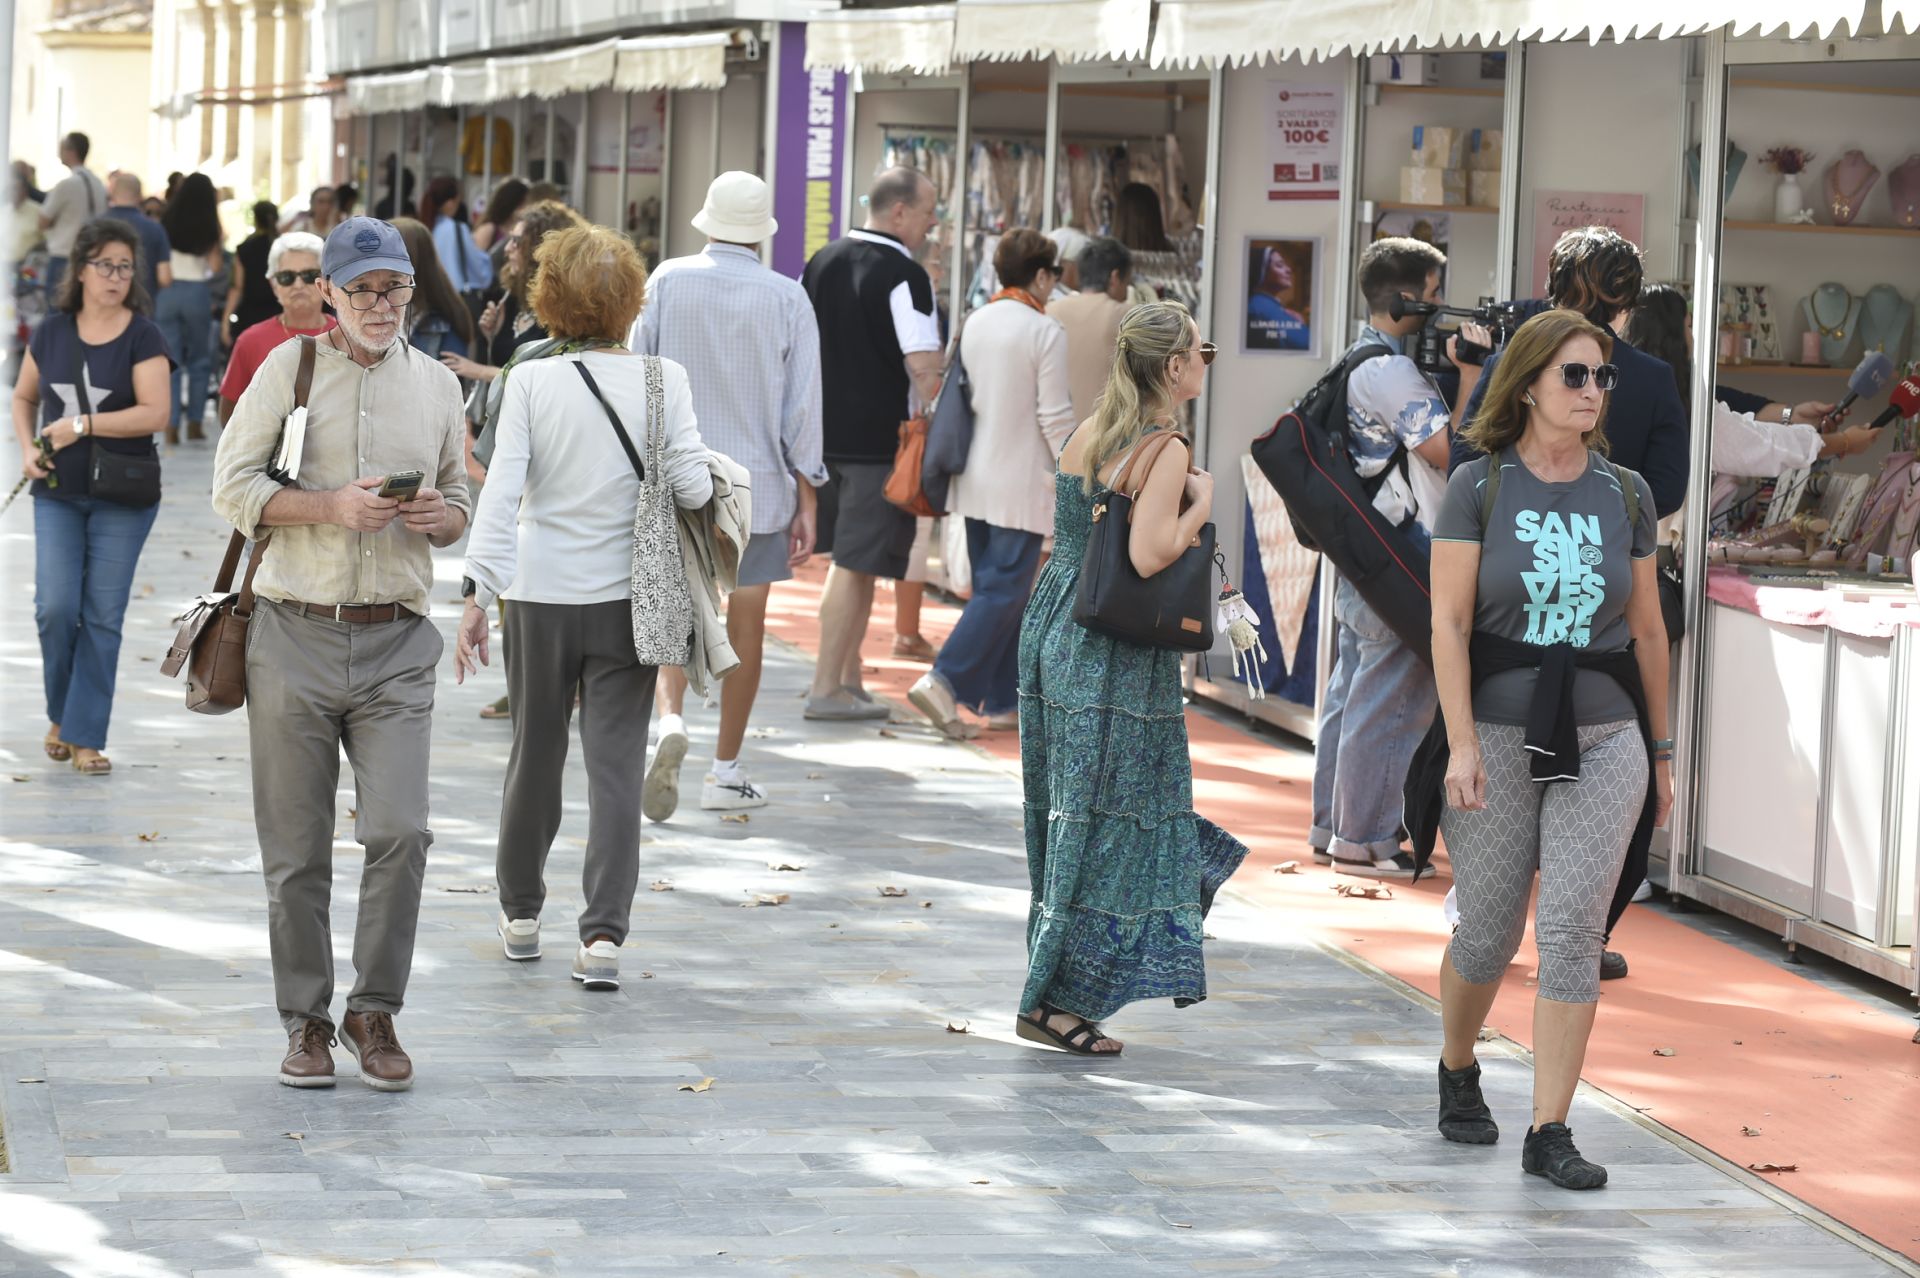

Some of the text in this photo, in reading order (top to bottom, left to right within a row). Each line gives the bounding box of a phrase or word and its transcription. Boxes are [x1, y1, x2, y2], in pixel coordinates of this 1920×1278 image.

[1283, 129, 1329, 144] 100€
[1286, 120, 1319, 128] VALES
[807, 127, 833, 177] PARA
[1515, 509, 1602, 545] SAN
[1520, 572, 1606, 607] VES
[1523, 603, 1593, 640] TRE
